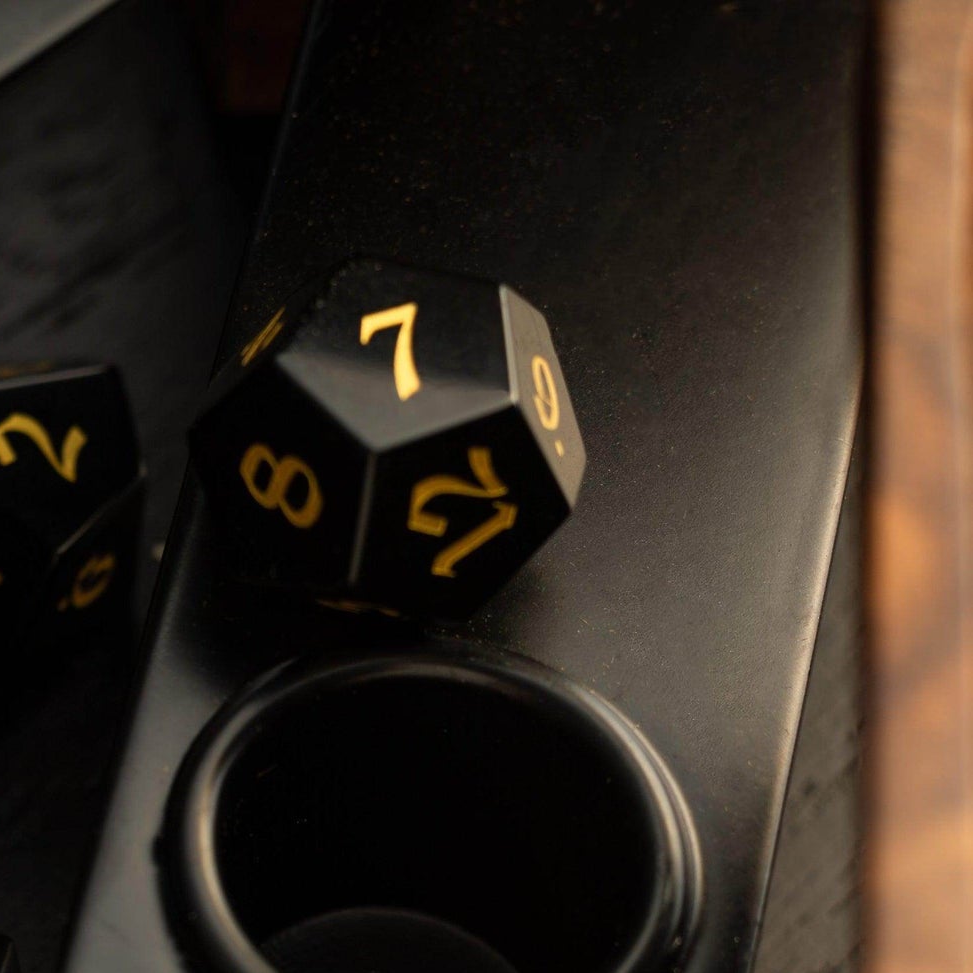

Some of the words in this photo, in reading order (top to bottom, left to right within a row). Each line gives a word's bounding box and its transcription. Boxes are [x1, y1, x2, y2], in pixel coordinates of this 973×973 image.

[359, 300, 424, 402] 7
[239, 442, 323, 530] 8
[407, 446, 518, 579] 12
